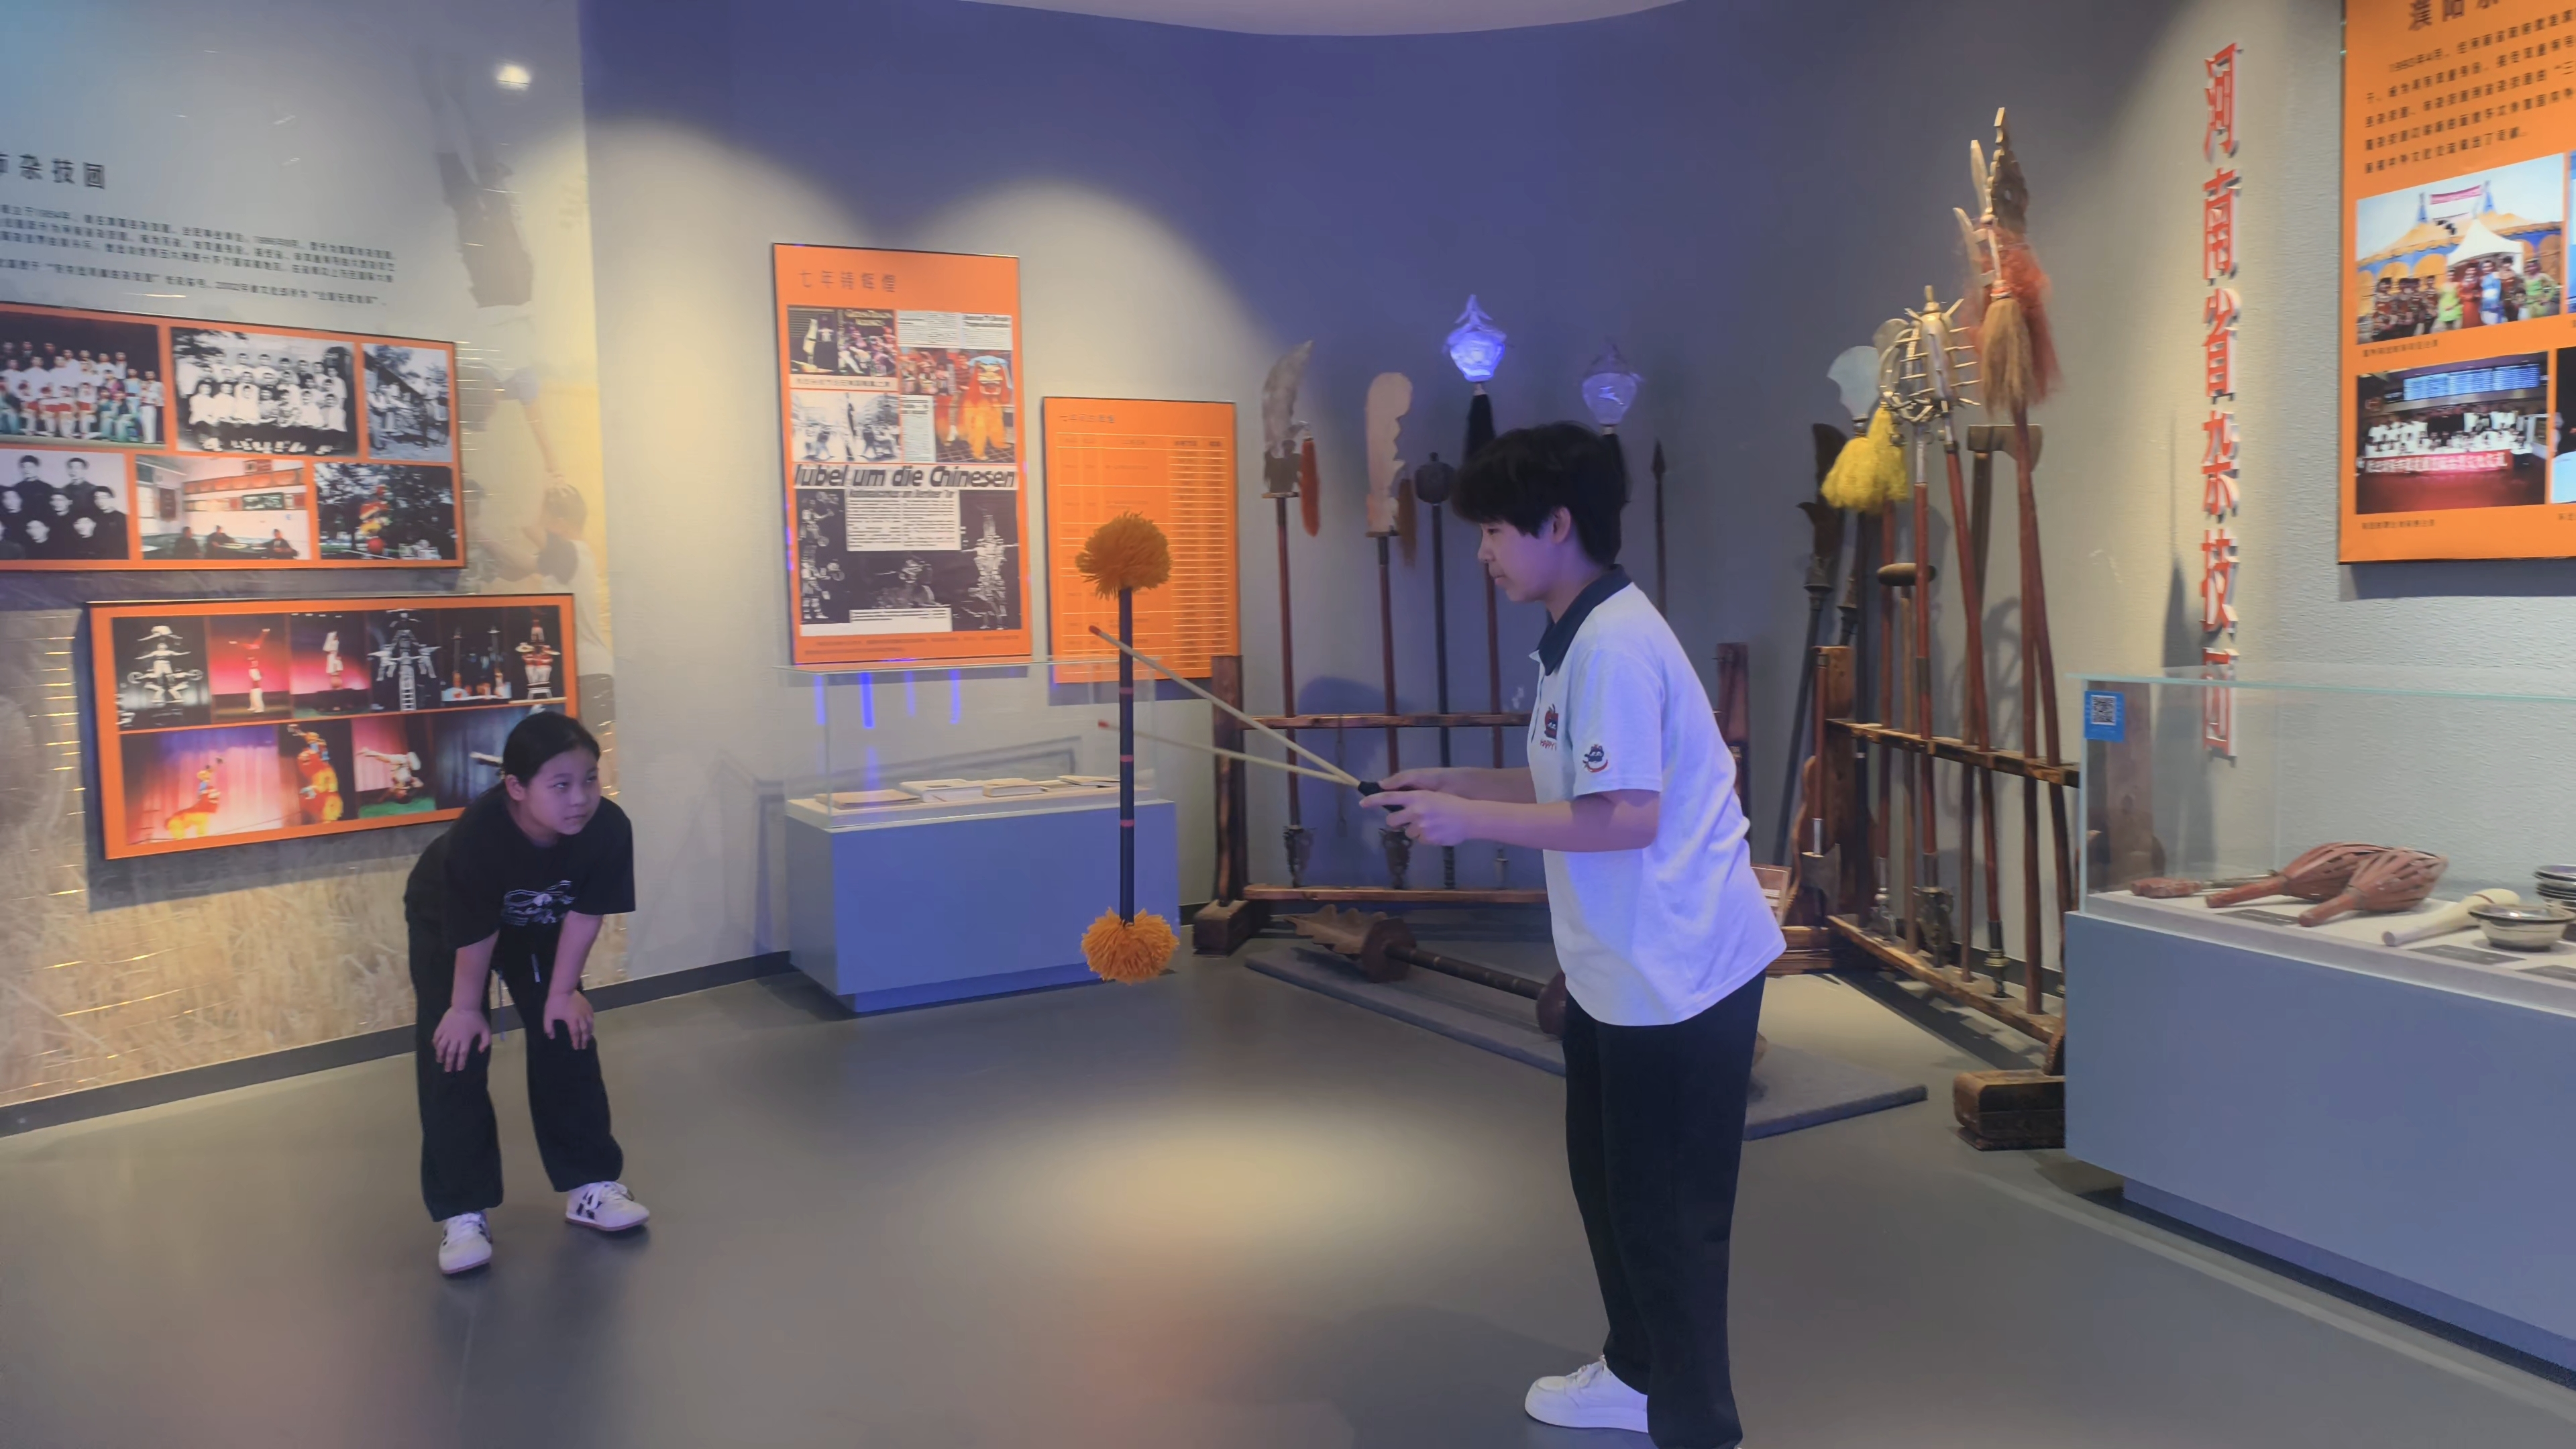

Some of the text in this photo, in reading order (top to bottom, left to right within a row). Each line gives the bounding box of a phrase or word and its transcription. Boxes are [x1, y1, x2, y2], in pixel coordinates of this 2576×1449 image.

[2408, 0, 2500, 31] 濮阳
[2200, 42, 2238, 757] 河南省杂技团
[853, 469, 886, 488] um
[892, 464, 923, 488] die
[929, 465, 1016, 488] Chinesen
